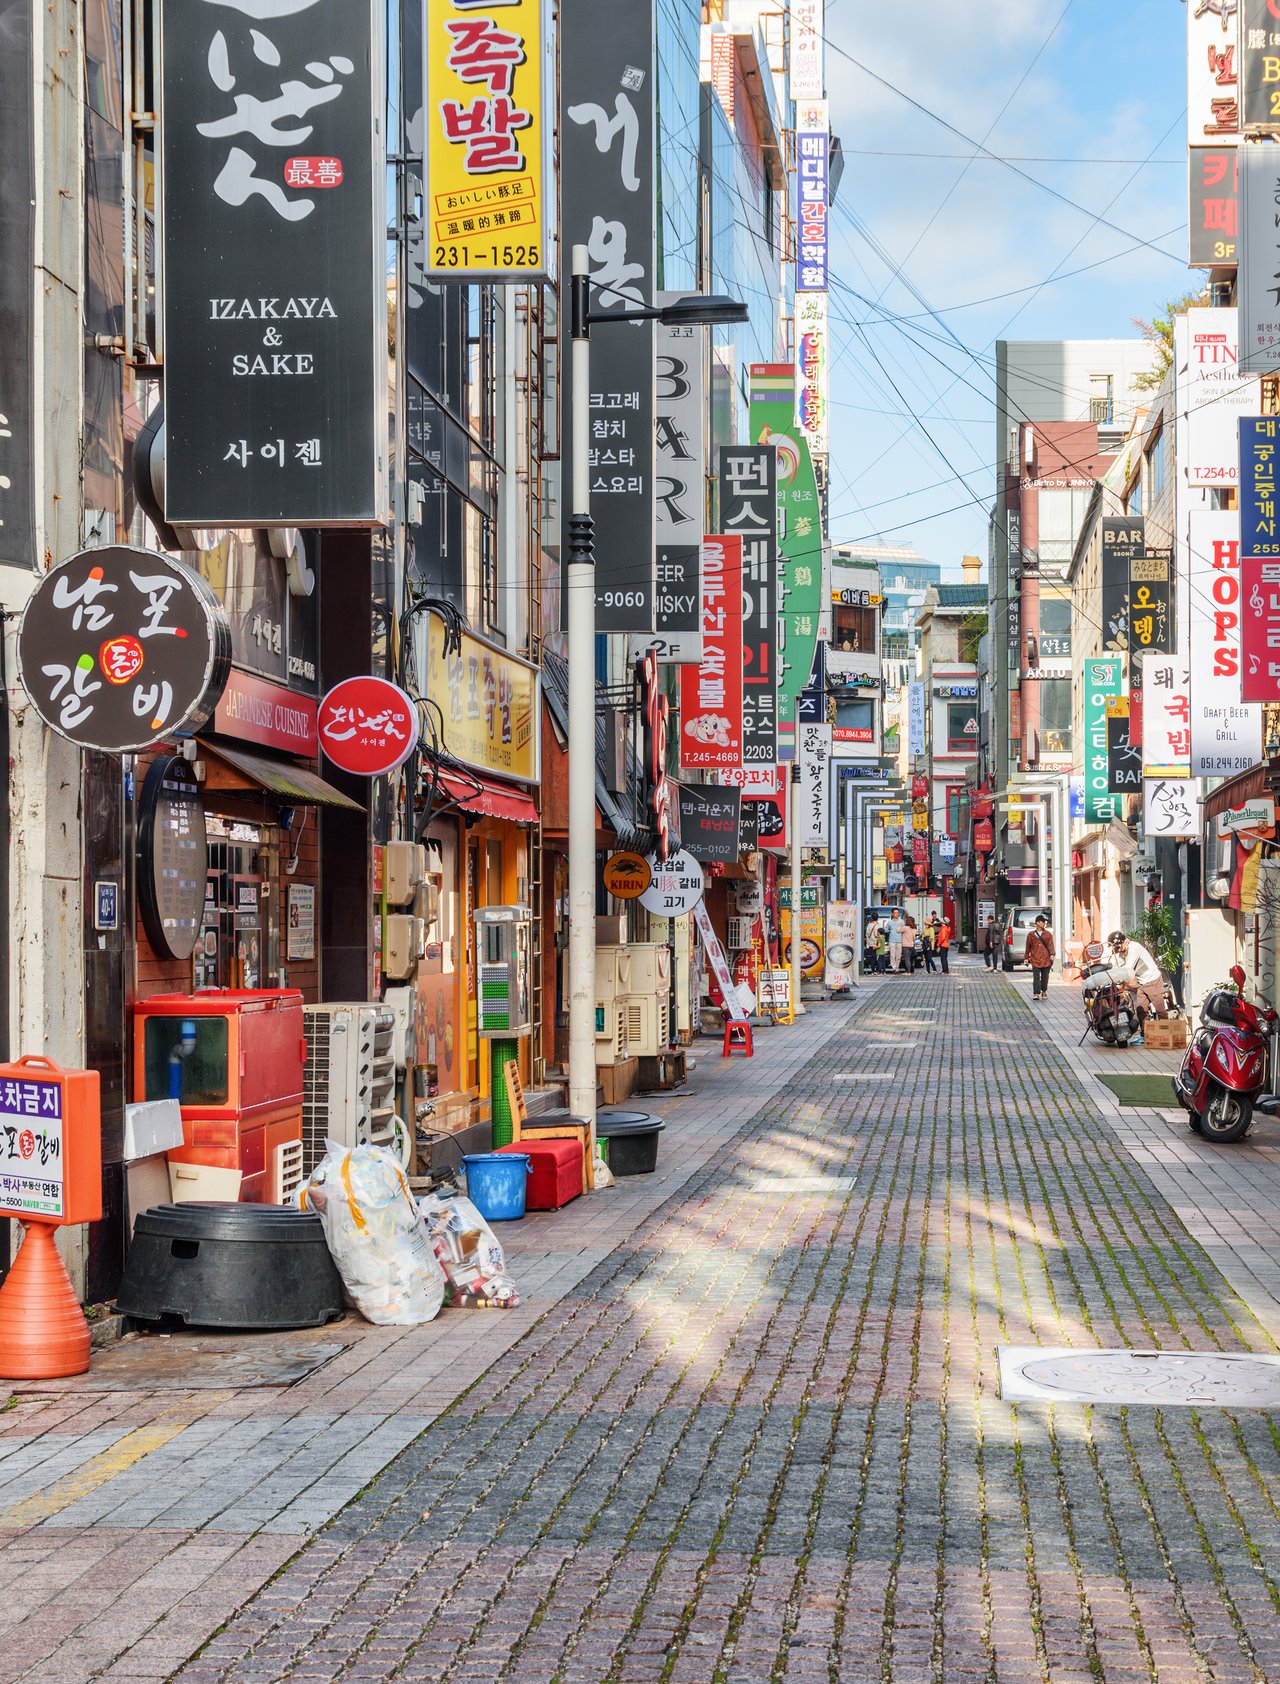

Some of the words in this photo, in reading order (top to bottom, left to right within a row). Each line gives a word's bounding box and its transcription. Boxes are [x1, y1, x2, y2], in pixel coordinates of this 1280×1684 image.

[441, 18, 528, 170] 족발
[287, 160, 342, 186] 最善
[446, 182, 525, 208] おいしい豚足
[435, 246, 539, 267] 231-1525
[1214, 241, 1235, 258] 3F
[209, 297, 338, 320] IZAKAYA
[263, 327, 283, 347] &
[669, 327, 695, 339] 코코
[232, 354, 314, 376] SAKE
[589, 392, 640, 411] 크고래
[592, 420, 627, 439] 참치
[656, 356, 697, 526] BAR
[223, 438, 323, 468] 사이젠
[589, 476, 644, 495] 스요리
[1253, 444, 1276, 536] 공인중개사
[1104, 530, 1143, 543] BAR
[1252, 544, 1280, 553] 255
[656, 565, 685, 583] EER
[1133, 561, 1166, 573] みなとまち
[702, 541, 727, 637] 용두산
[594, 591, 645, 607] -9060
[1132, 585, 1156, 645] 오뎅
[1211, 540, 1240, 678] HOPS
[1155, 599, 1167, 643] おでん
[650, 639, 682, 658] 2F
[697, 645, 727, 709] 숯불
[41, 654, 173, 730] 갈비
[226, 687, 274, 729] JAPANESE
[274, 704, 310, 739] CUISINE
[743, 694, 774, 713] 스트
[743, 717, 774, 735] 우스
[684, 752, 739, 764] T.245-4669
[735, 769, 775, 789] 양꼬치
[685, 844, 731, 854] 255-0102
[652, 860, 686, 872] 삼겹살
[610, 880, 643, 890] KIRIN
[678, 877, 700, 889] 갈비
[101, 897, 115, 917] 40-1
[663, 896, 685, 908] 고기
[761, 983, 789, 1000] 숙박
[0, 1081, 60, 1116] 차금지
[22, 1180, 41, 1191] 부동산
[42, 1182, 60, 1199] 연합
[22, 1200, 40, 1209] NAVER
